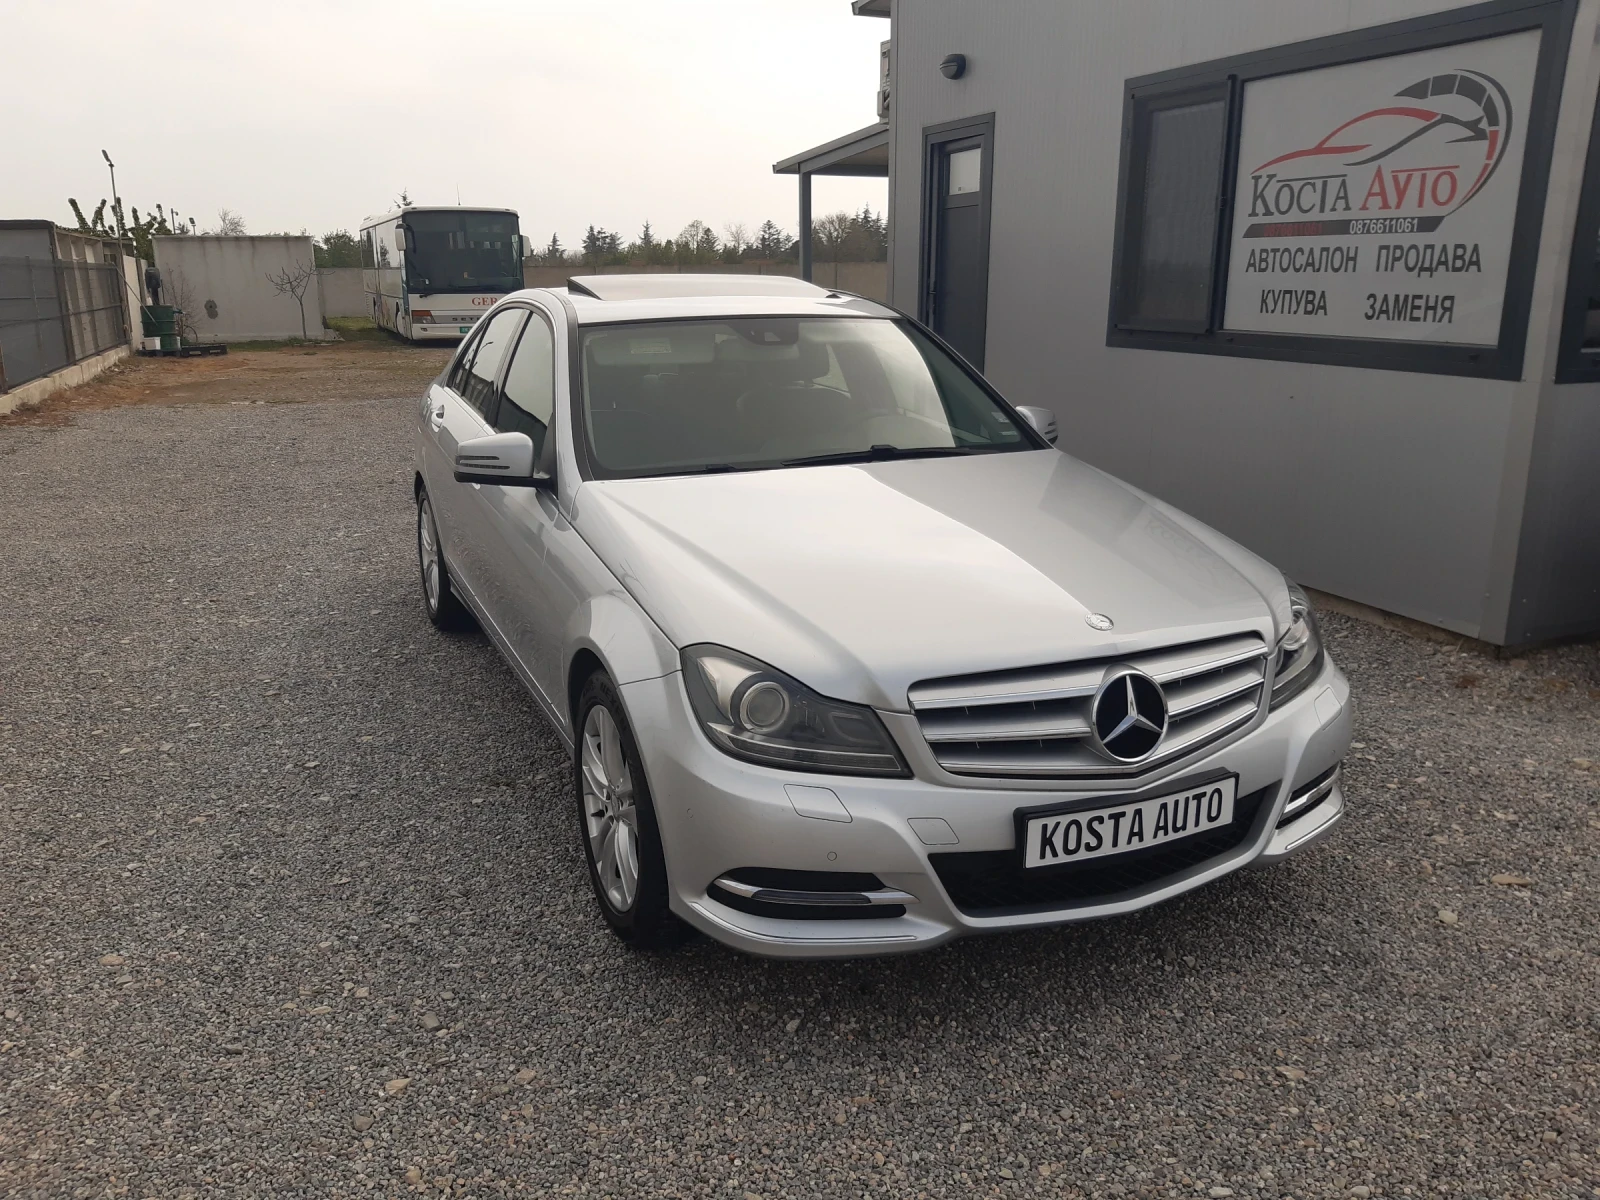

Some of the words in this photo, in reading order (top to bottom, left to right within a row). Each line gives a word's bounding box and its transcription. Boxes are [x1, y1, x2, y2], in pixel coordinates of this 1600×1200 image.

[1350, 217, 1418, 234] 0876611061
[1245, 246, 1359, 273] АВТОСАЛОН
[1375, 243, 1482, 278] ПРОДАВА
[1260, 289, 1328, 316] КУПУВА
[1364, 293, 1455, 324] ЗАМЕНЯ
[1039, 808, 1144, 860] KOSTA
[1152, 787, 1223, 839] AUTO
